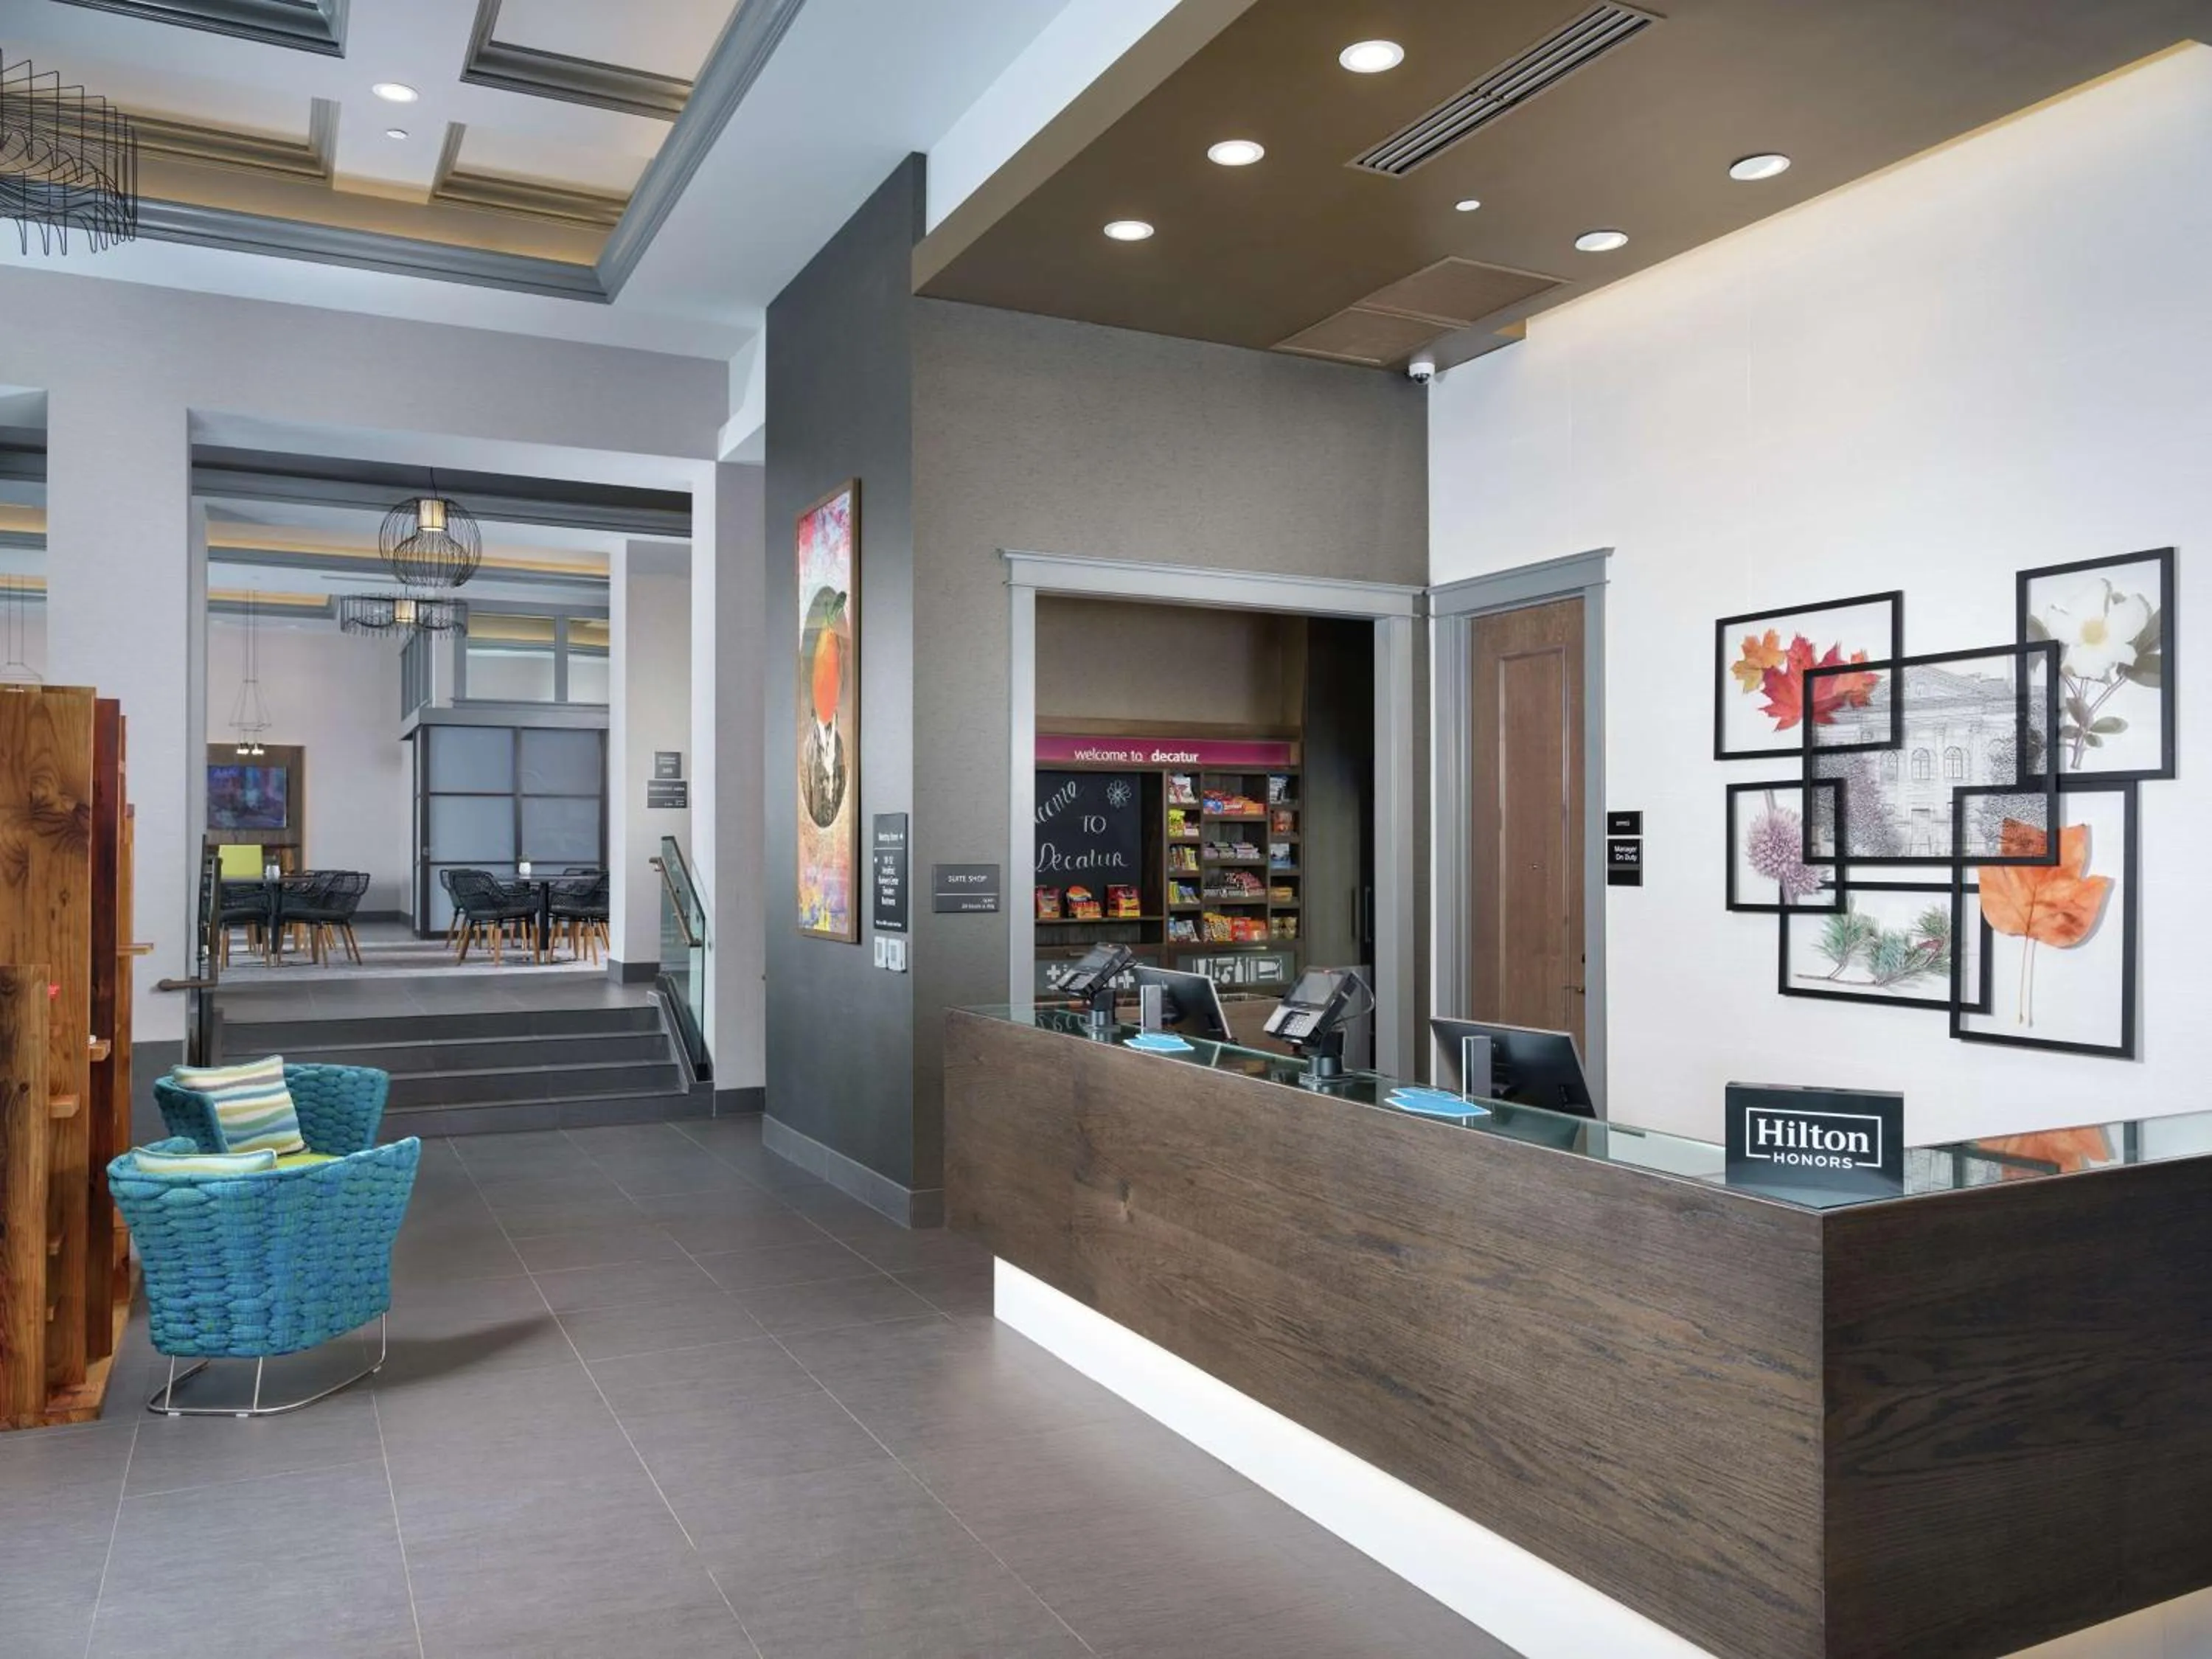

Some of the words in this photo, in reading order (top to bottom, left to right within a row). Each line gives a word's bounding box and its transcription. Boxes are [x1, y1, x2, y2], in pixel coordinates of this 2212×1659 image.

[1074, 747, 1127, 761] welcome
[1130, 750, 1143, 762] to
[1151, 749, 1199, 762] decatur
[1757, 1118, 1870, 1153] Hilton
[1773, 1152, 1853, 1169] HONORS
